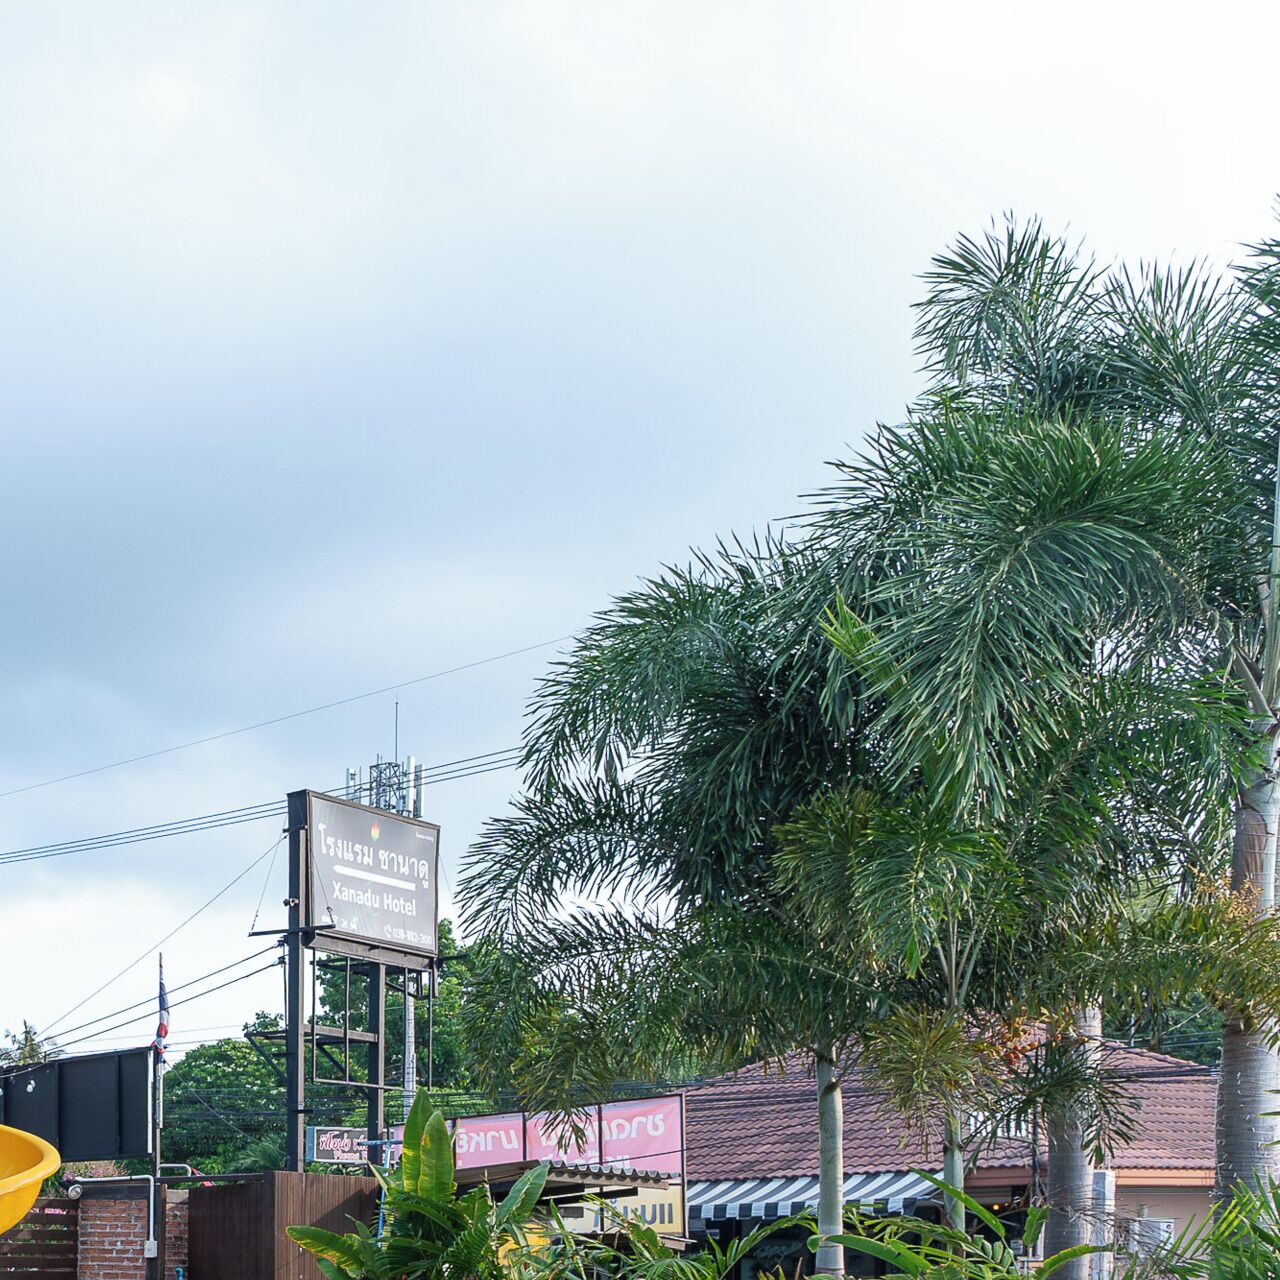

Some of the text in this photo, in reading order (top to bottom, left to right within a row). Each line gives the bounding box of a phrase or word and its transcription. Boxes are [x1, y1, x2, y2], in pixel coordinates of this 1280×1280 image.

[317, 822, 374, 867] โรงแรม
[332, 880, 416, 916] Xanadu Hotel
